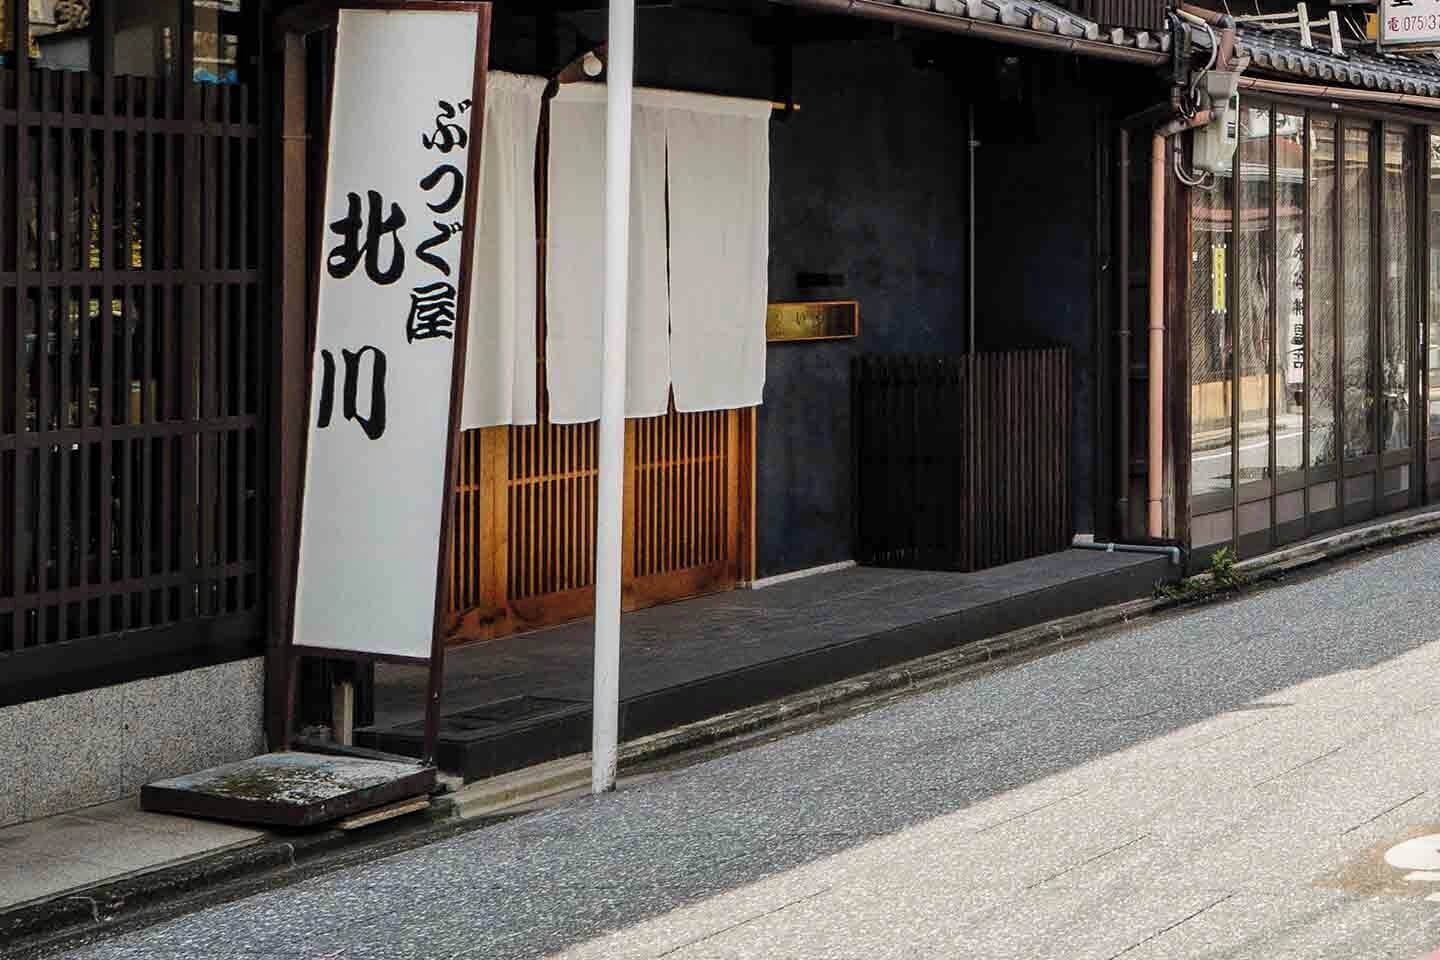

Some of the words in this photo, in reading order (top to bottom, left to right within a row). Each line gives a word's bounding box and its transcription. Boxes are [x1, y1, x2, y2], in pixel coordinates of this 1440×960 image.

[316, 189, 407, 440] 北川
[406, 98, 473, 344] ぶつぐ屋
